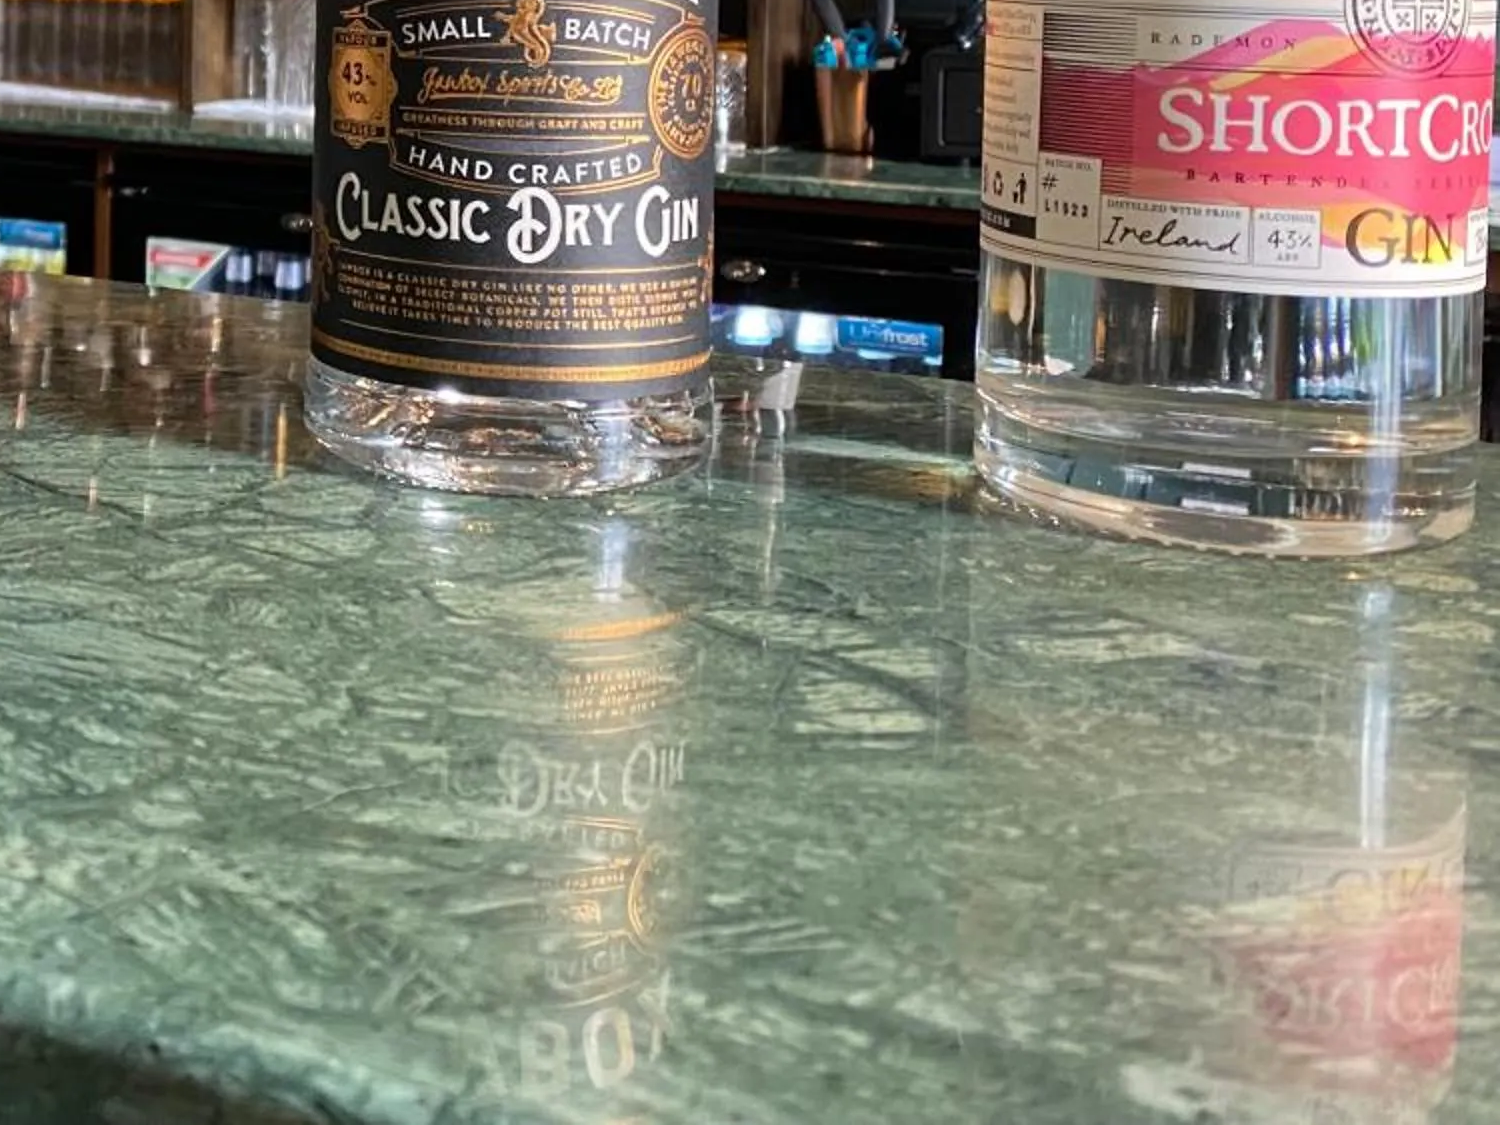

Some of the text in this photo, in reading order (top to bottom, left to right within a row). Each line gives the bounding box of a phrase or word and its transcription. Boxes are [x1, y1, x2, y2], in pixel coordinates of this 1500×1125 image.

[402, 17, 492, 46] SMALL
[565, 17, 652, 51] BATCH
[1151, 31, 1297, 51] RADEMON
[348, 90, 368, 105] VOL
[402, 111, 644, 131] GREATNESS THROUGH GRAFT AND CRAFT
[408, 144, 643, 186] HAND CRAFTED
[336, 172, 700, 264] CLASSIC DRY GIN
[1101, 216, 1242, 255] Ireland
[1267, 228, 1313, 250] 43%
[1345, 207, 1457, 267] GIN
[397, 272, 448, 288] CLASSIC
[451, 278, 477, 290] DRY
[482, 280, 507, 292] GIN
[512, 281, 543, 293] LIKE
[546, 283, 567, 294] NO
[401, 295, 480, 315] TRADITIONAL
[485, 305, 537, 317] COPPER
[543, 307, 568, 318] POT
[547, 295, 567, 307] WE
[571, 295, 603, 308] THEN
[441, 313, 470, 327] TIME
[476, 315, 493, 328] TO
[497, 317, 561, 331] PRODUCE
[565, 319, 589, 331] THE
[593, 318, 621, 332] BEST
